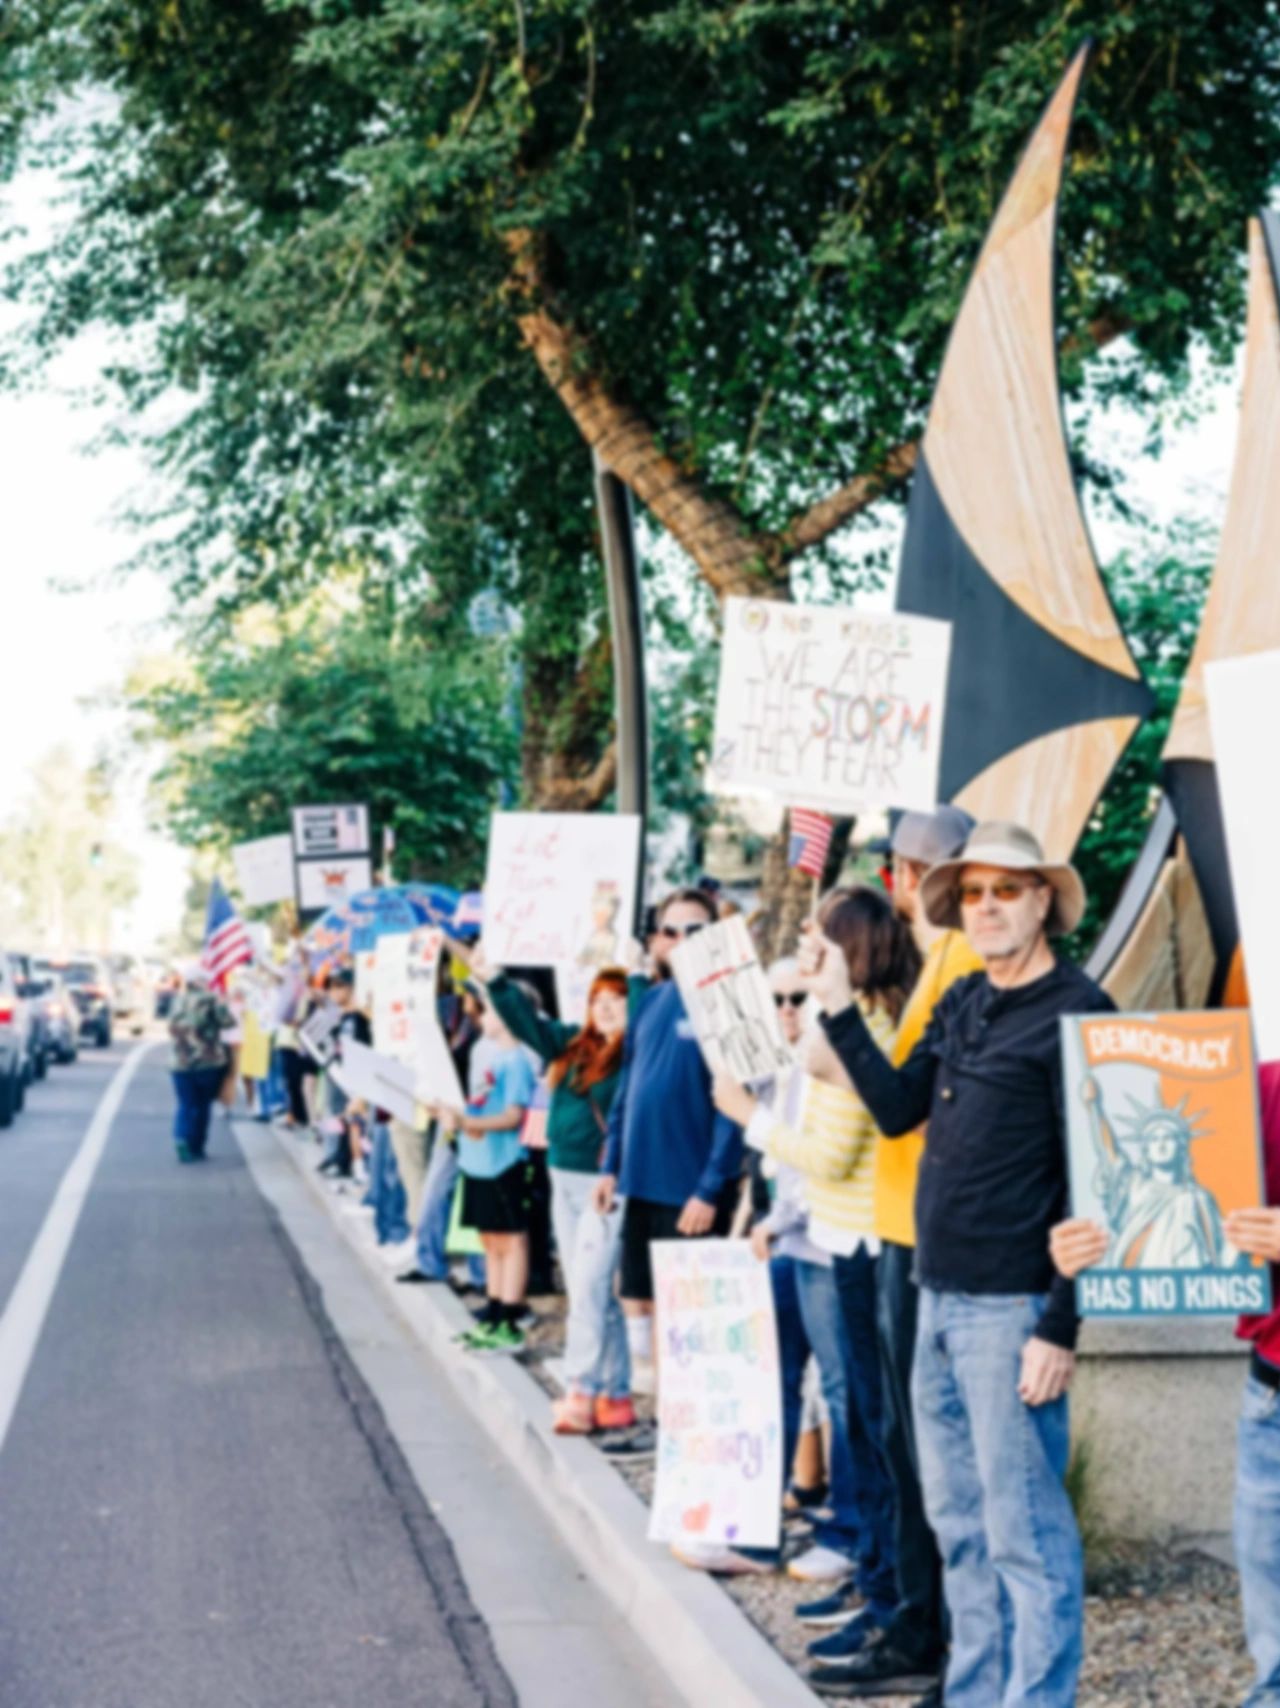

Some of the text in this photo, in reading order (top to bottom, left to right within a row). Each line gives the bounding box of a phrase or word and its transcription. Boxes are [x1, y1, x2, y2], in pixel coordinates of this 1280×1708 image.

[759, 638, 914, 703] WE ARE
[743, 676, 932, 753] THE STORM
[739, 722, 902, 792] THEY FEAR
[1087, 1023, 1234, 1070] DEMOCRACY
[1080, 1276, 1263, 1311] HAS NO KINGS
